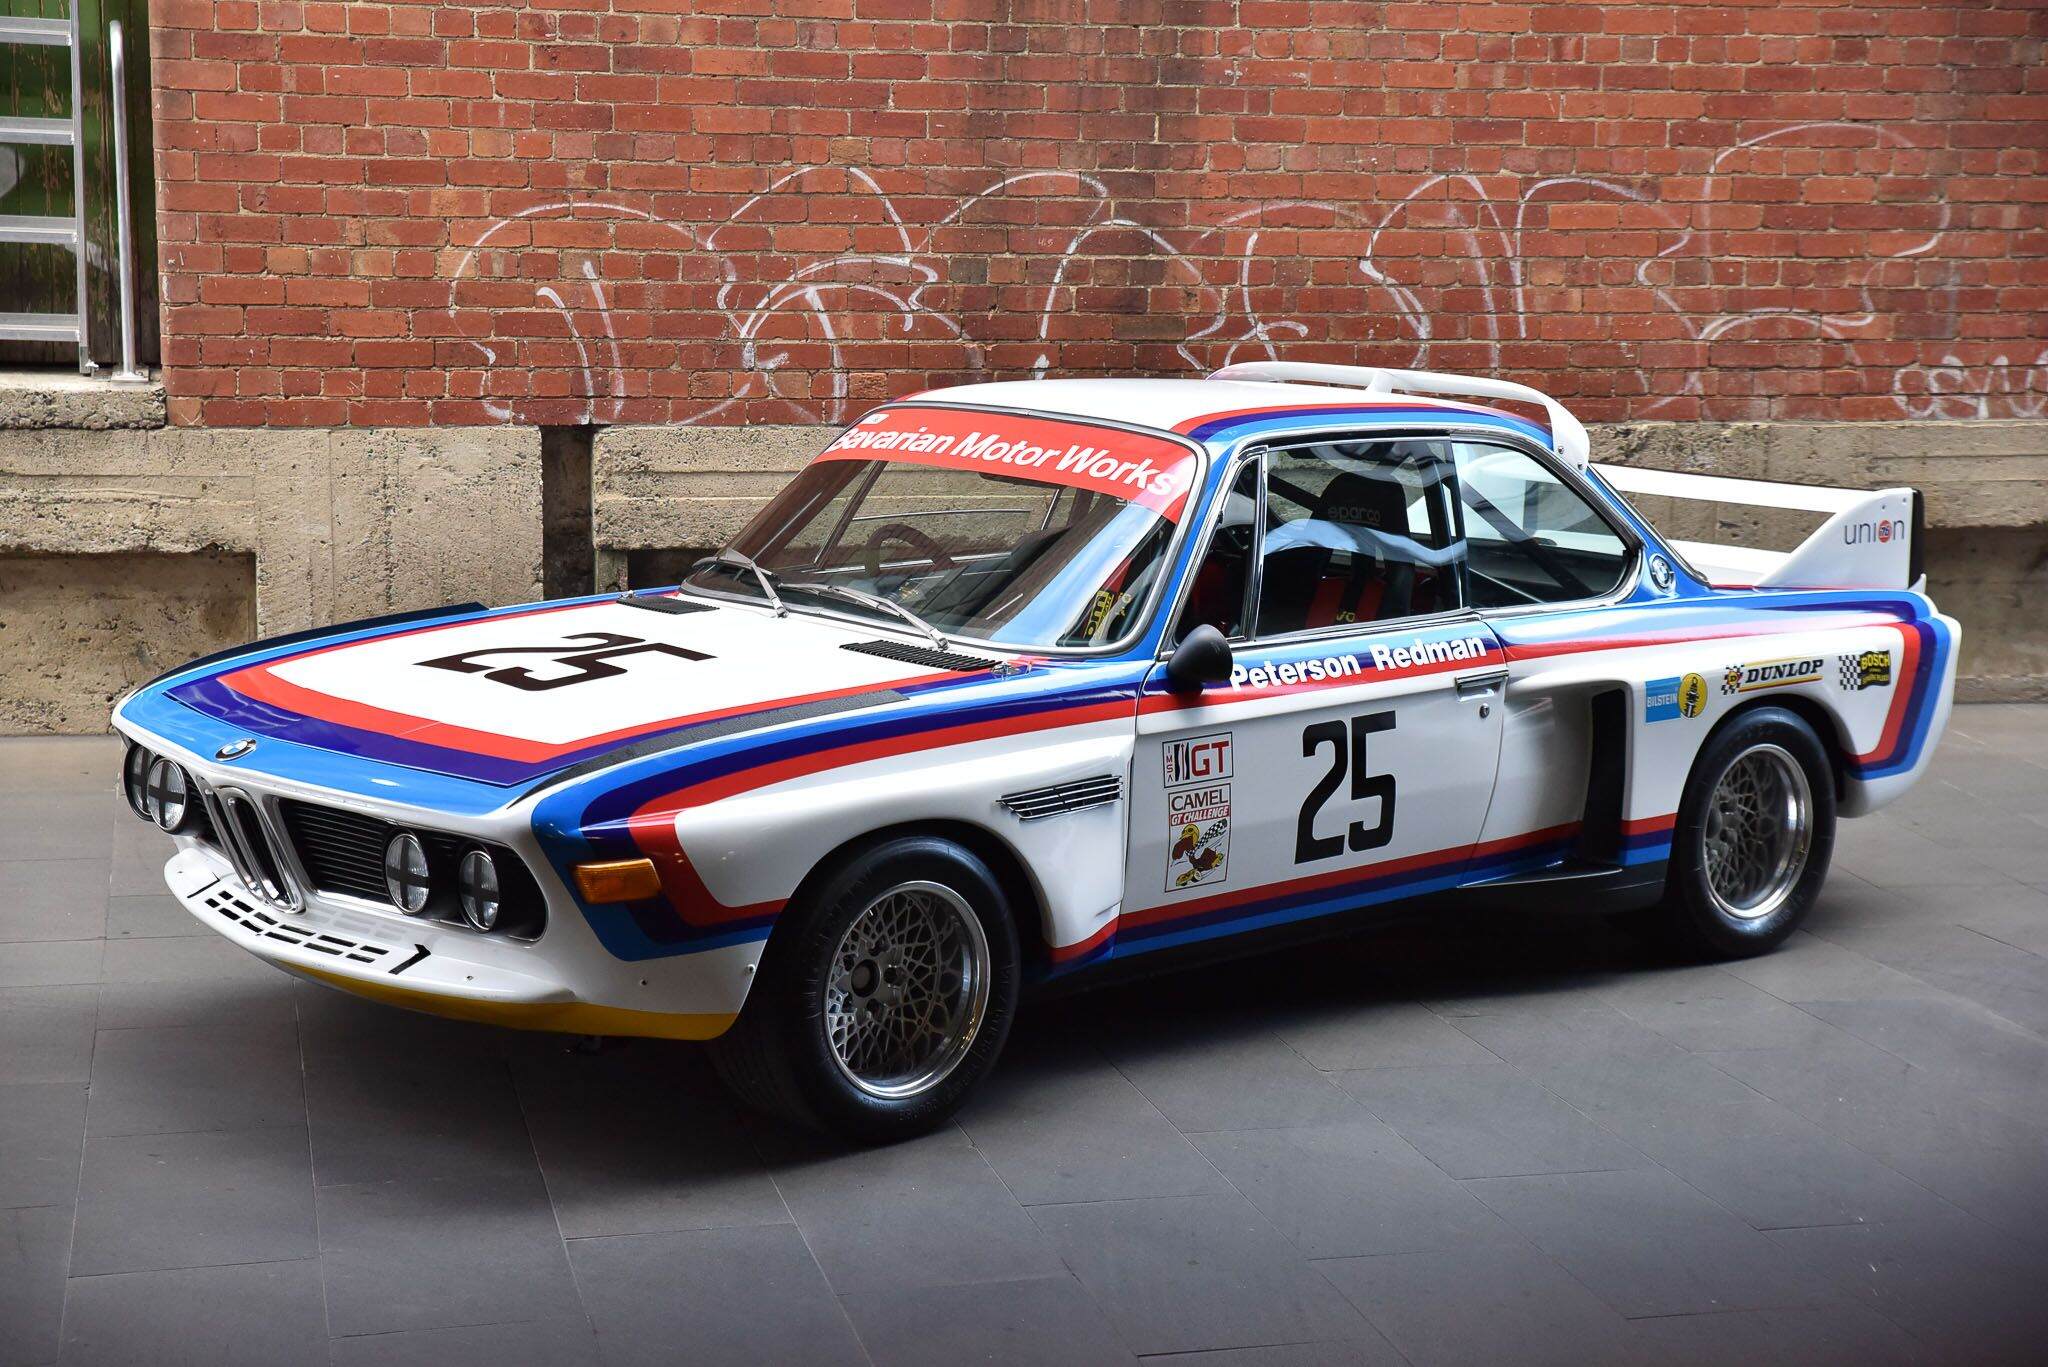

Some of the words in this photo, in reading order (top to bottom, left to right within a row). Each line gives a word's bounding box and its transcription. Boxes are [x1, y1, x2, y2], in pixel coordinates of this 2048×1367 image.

[949, 431, 1062, 468] Motor
[1055, 444, 1177, 496] Works
[411, 632, 719, 691] 25
[1230, 653, 1362, 692] Peterson
[1369, 637, 1487, 671] Redman
[1745, 658, 1824, 684] DUNLOP
[1861, 653, 1890, 670] BOSCH
[1647, 692, 1678, 708] BILSTEIN
[1191, 740, 1230, 777] GT
[1171, 789, 1228, 812] CAMEL
[1294, 710, 1397, 864] 25
[1171, 813, 1183, 826] GT
[1183, 805, 1229, 824] CHALLENGE
